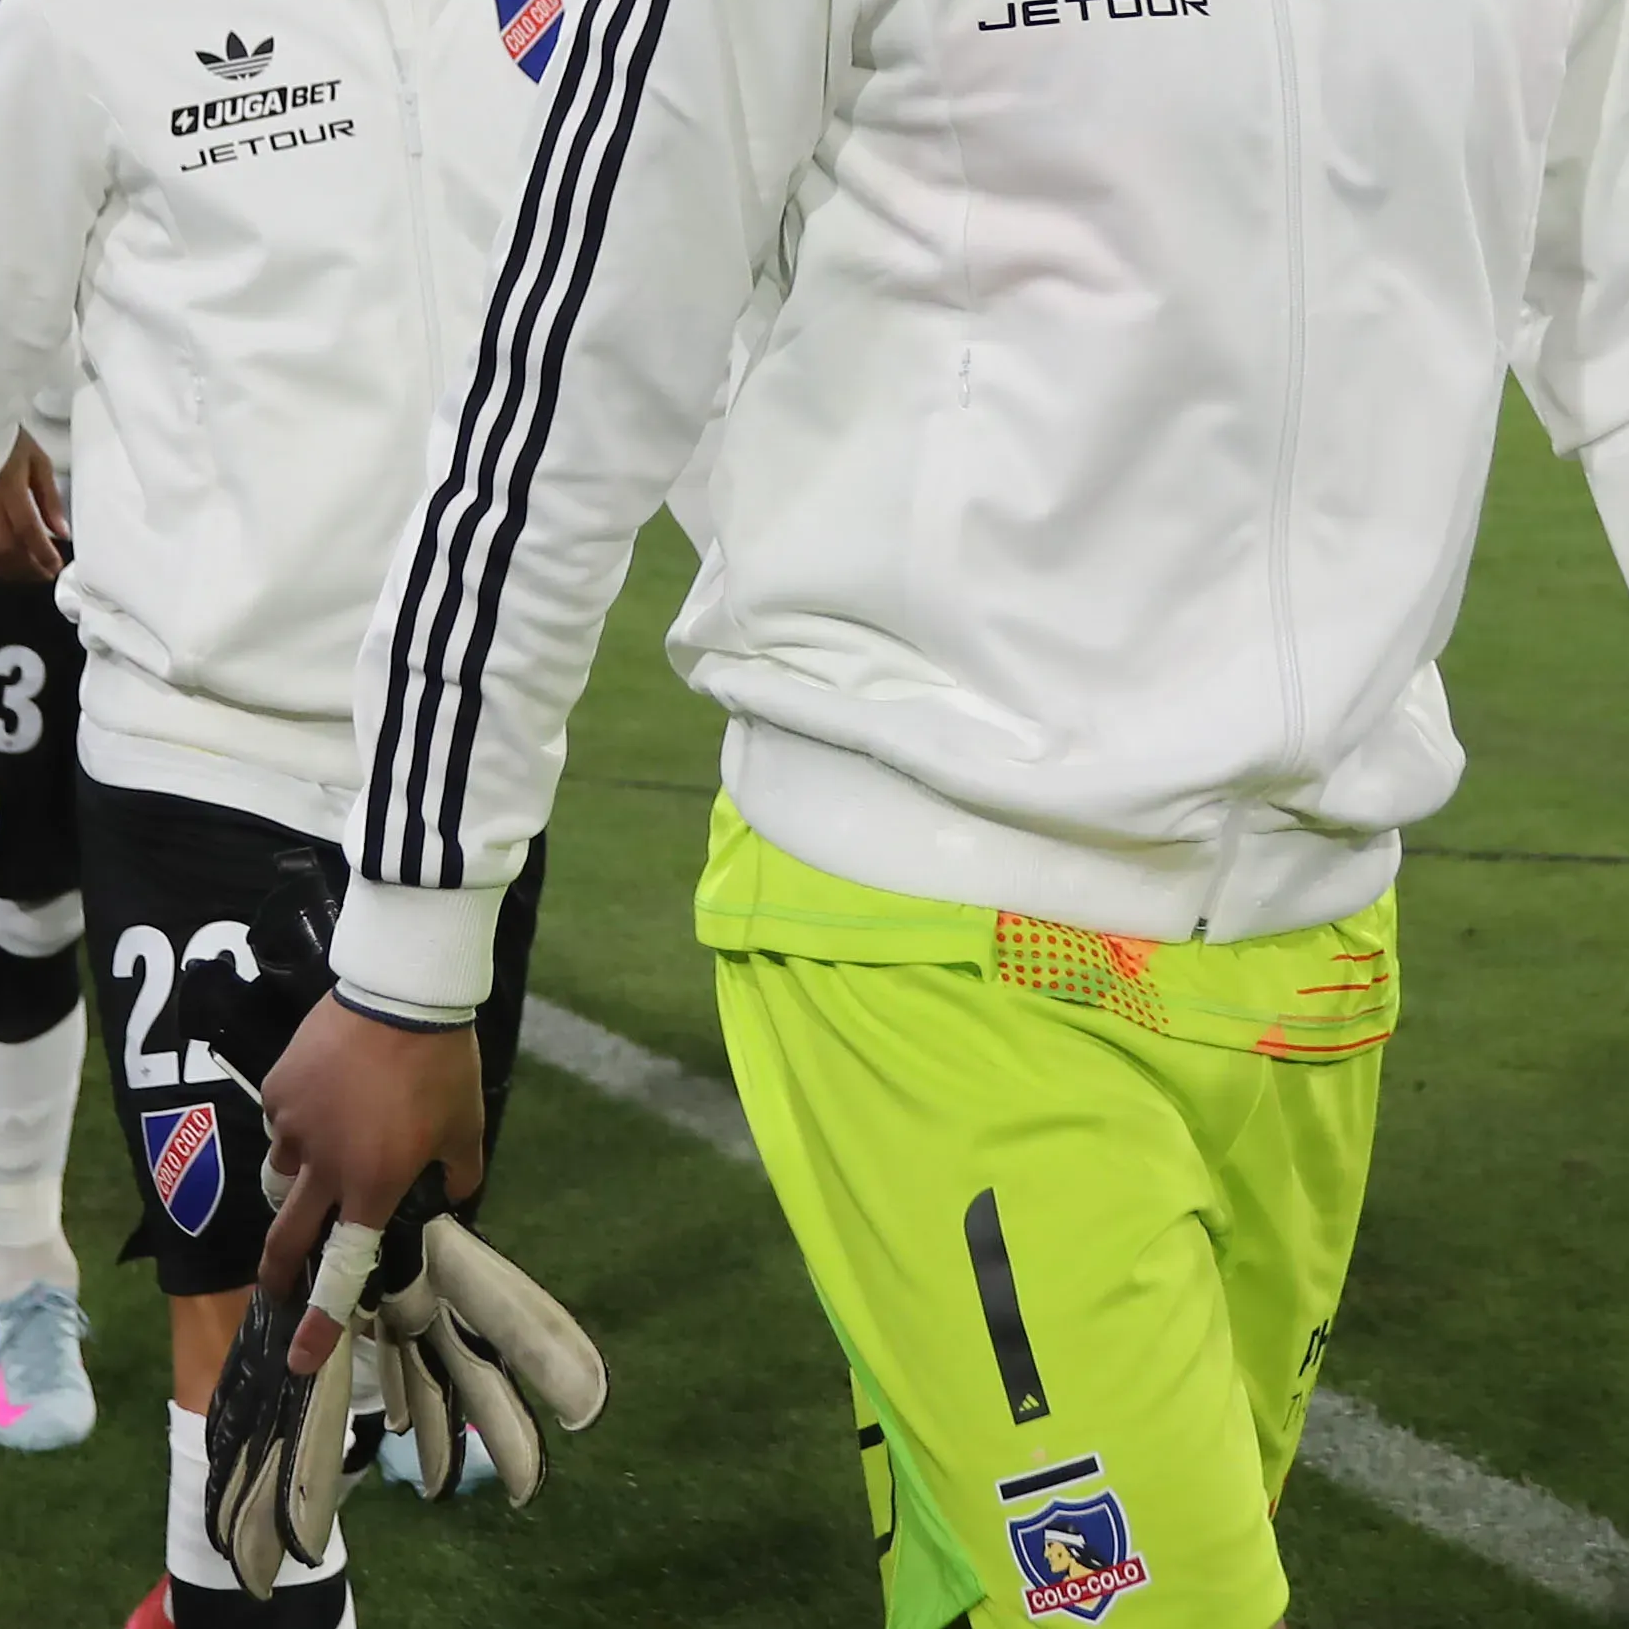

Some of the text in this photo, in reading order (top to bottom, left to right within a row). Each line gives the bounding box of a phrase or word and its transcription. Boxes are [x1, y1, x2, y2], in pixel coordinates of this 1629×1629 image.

[504, 15, 537, 53] COLO
[180, 119, 356, 173] JETOUR
[174, 1111, 209, 1157] COLO
[1032, 1562, 1139, 1610] COLO-COLO
